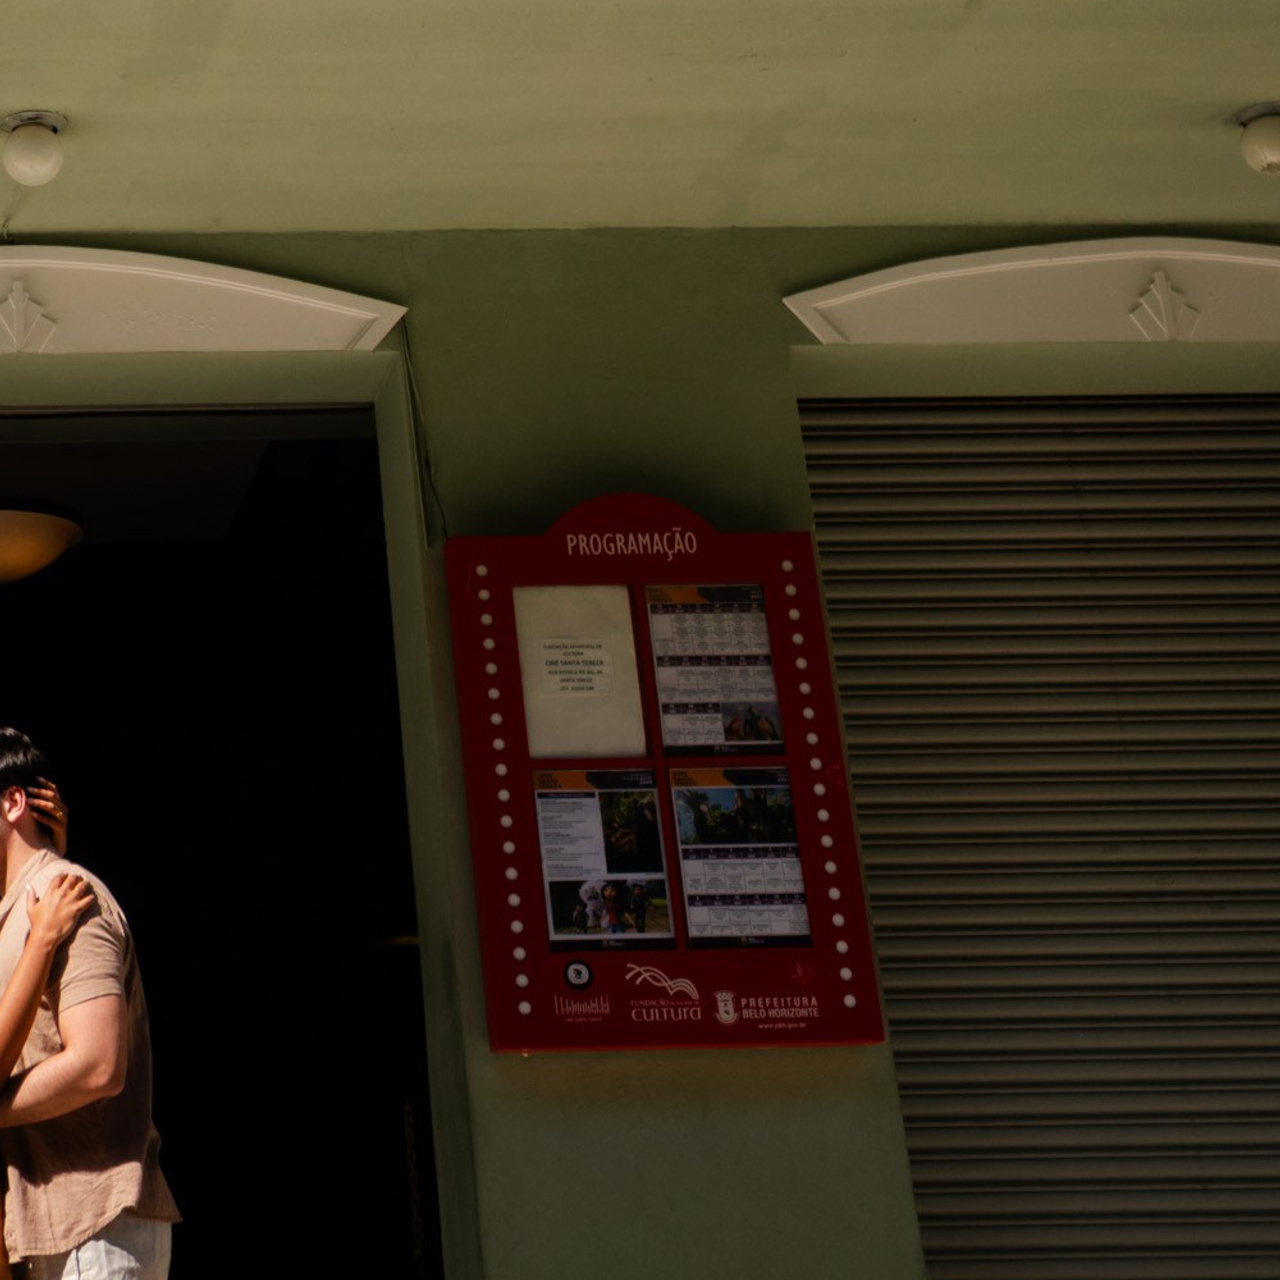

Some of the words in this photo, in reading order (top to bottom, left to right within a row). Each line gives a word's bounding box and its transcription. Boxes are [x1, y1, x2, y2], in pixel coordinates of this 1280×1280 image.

[566, 527, 698, 562] PROGRAMAÇÃO
[740, 996, 818, 1008] PREFEITURA
[742, 1008, 766, 1019] BELO
[767, 1007, 820, 1019] HORIZONTE
